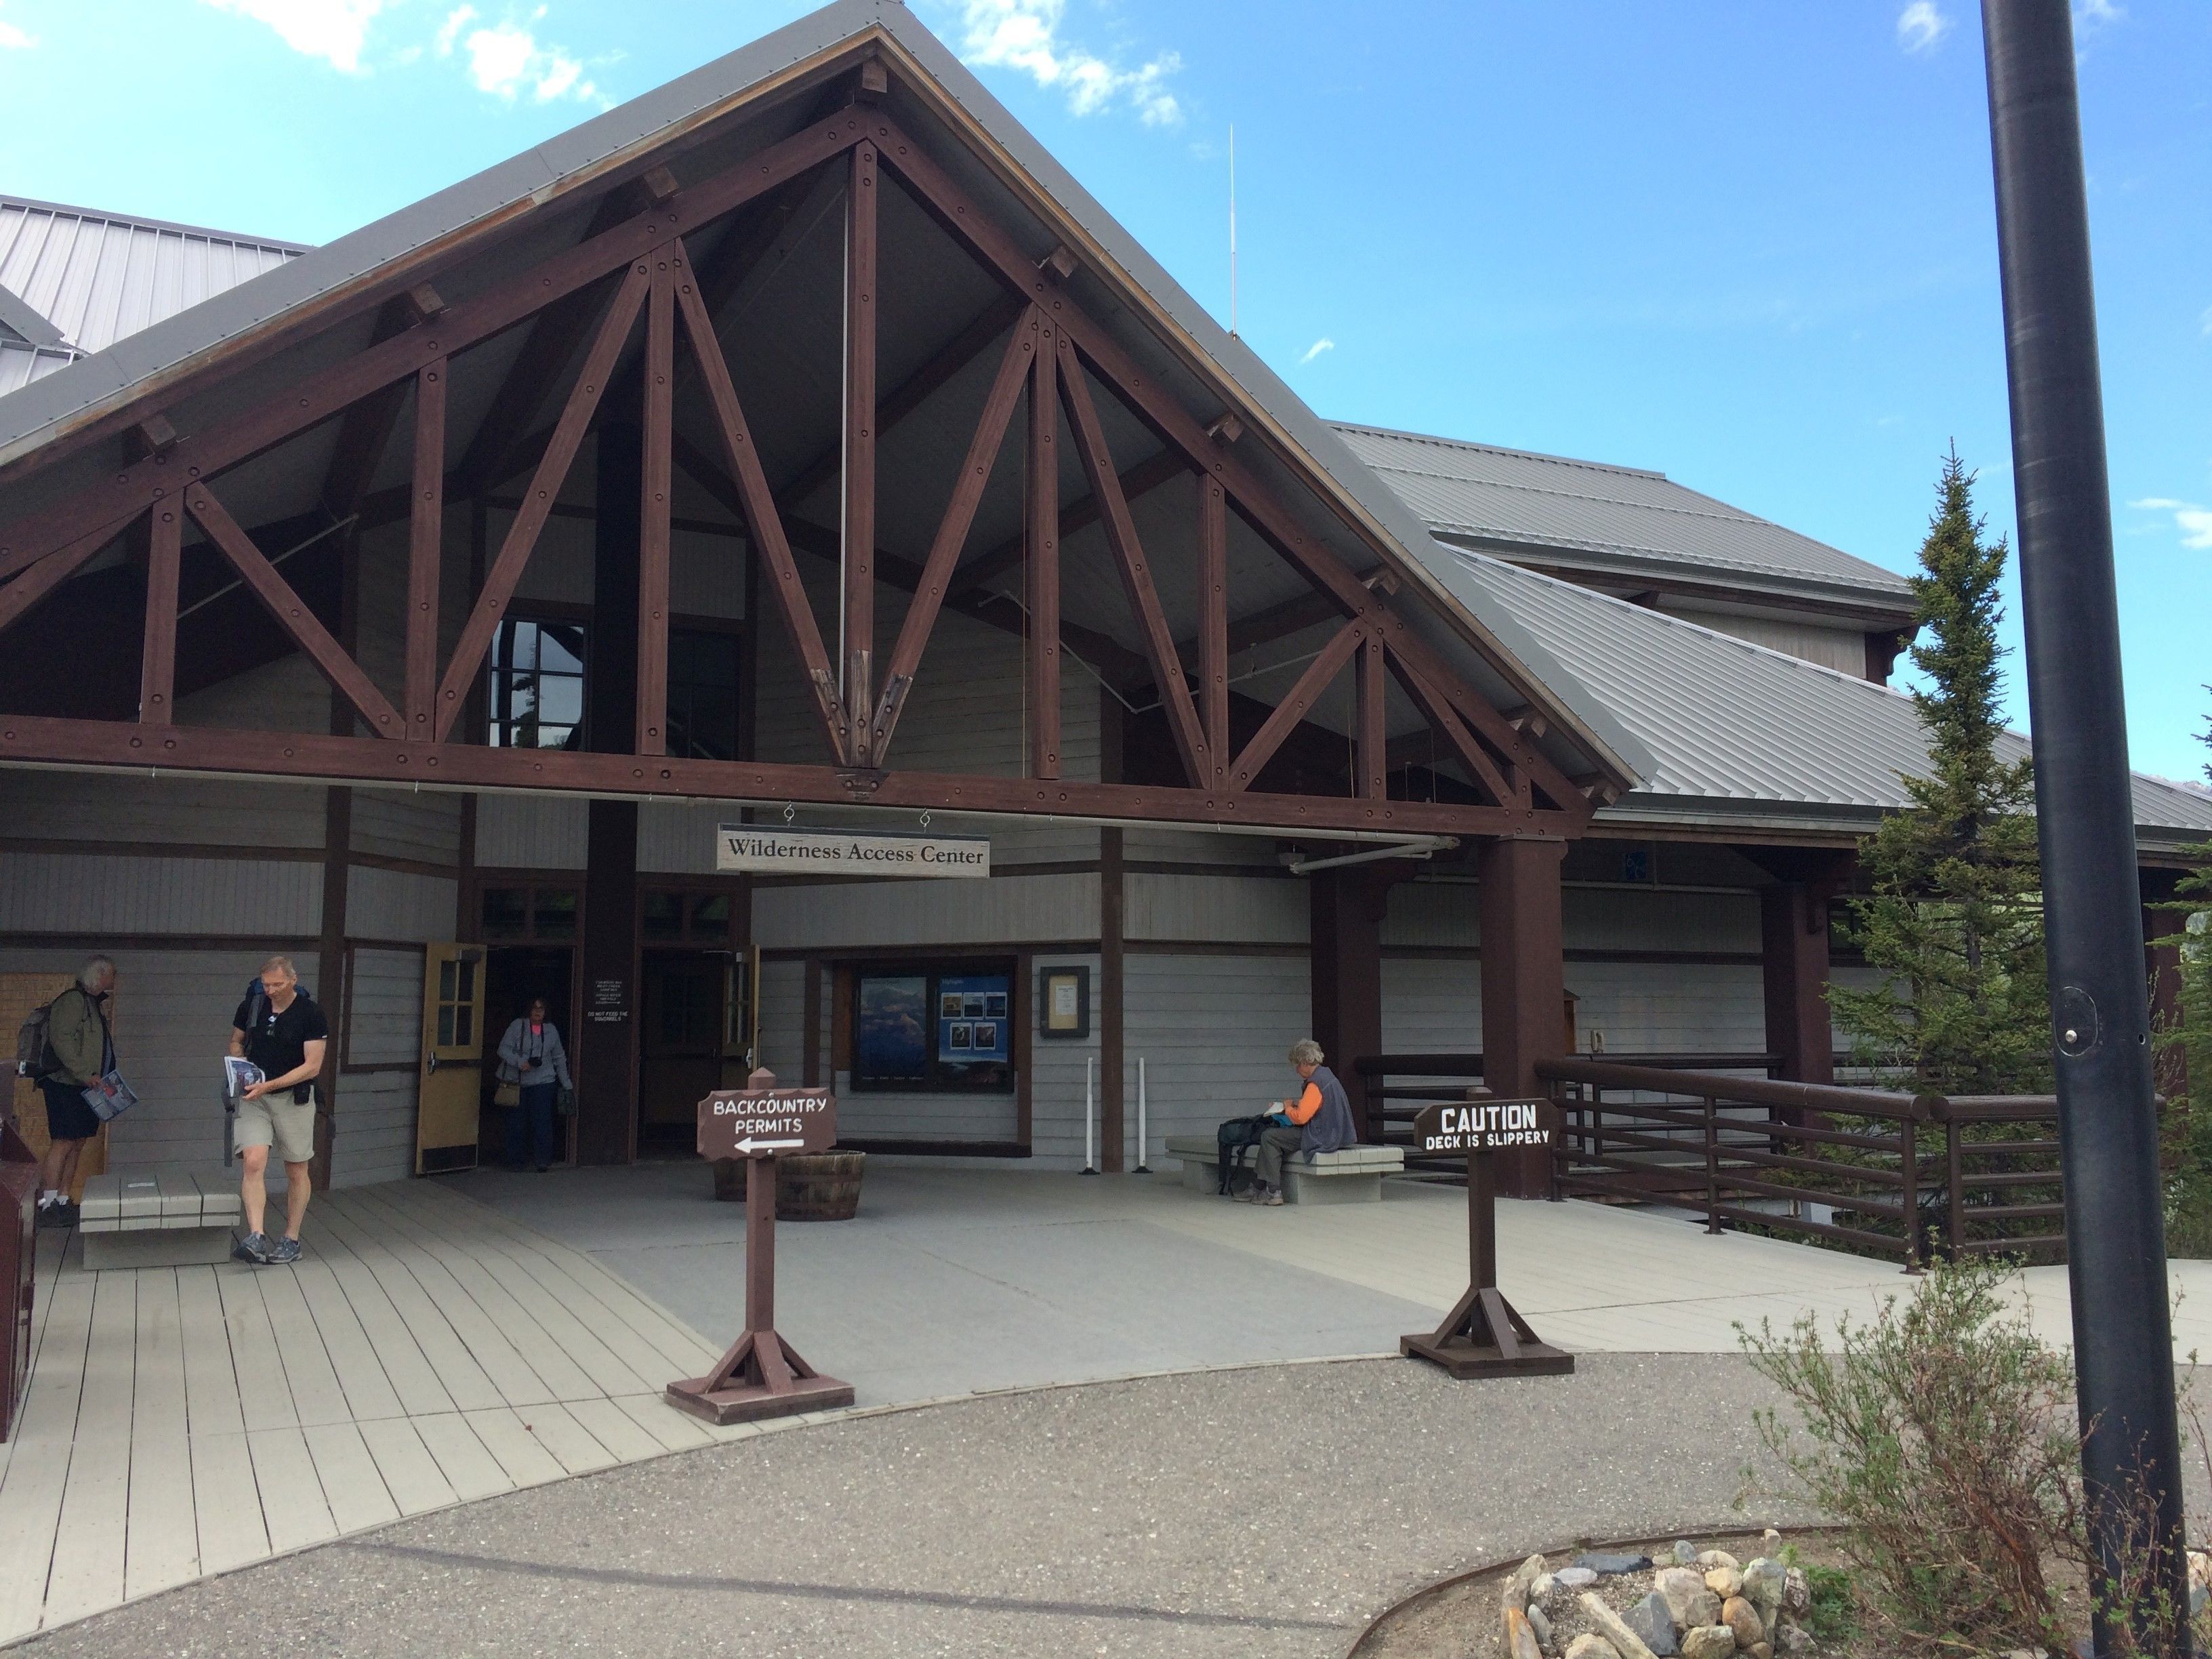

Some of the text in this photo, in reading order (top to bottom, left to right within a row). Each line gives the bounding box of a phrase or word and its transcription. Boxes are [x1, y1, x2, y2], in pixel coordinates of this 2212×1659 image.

[728, 838, 984, 864] Wilderness Access Center
[714, 1098, 827, 1115] BACKCOUNTRY
[735, 1118, 802, 1134] PERMITS
[1441, 1104, 1536, 1133] CAUTION
[1426, 1130, 1549, 1150] DECK IS SLIPPERY
